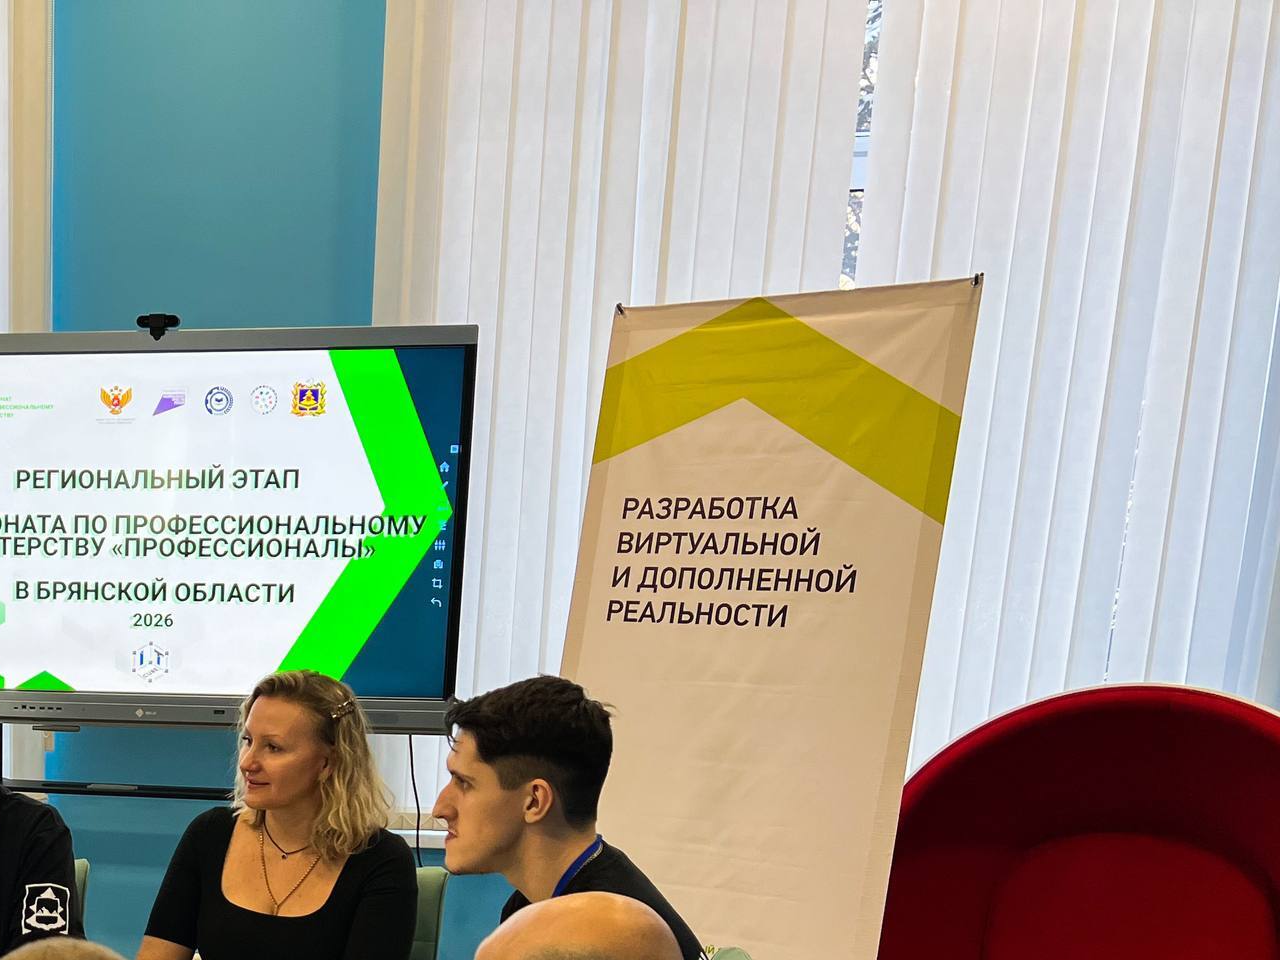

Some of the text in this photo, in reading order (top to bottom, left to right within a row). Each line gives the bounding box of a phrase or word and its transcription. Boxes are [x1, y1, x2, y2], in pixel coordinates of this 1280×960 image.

[16, 464, 300, 489] РЕГИОНАЛЬНЫЙ ЭТАП
[622, 496, 798, 519] РАЗРАБОТКА
[74, 515, 108, 534] ПО
[115, 515, 428, 535] ПРОФЕССИОНАЛЬНОМУ
[112, 537, 376, 558] «ПРОФЕССИОНАЛЫ»
[616, 527, 820, 555] ВИРТУАЛЬНОЙ
[15, 577, 296, 603] В БРЯНСКОЙ ОБЛАСТИ
[611, 564, 857, 593] И ДОПОЛНЕННОЙ
[133, 613, 174, 628] 2026
[606, 600, 788, 628] РЕАЛЬНОСТИ
